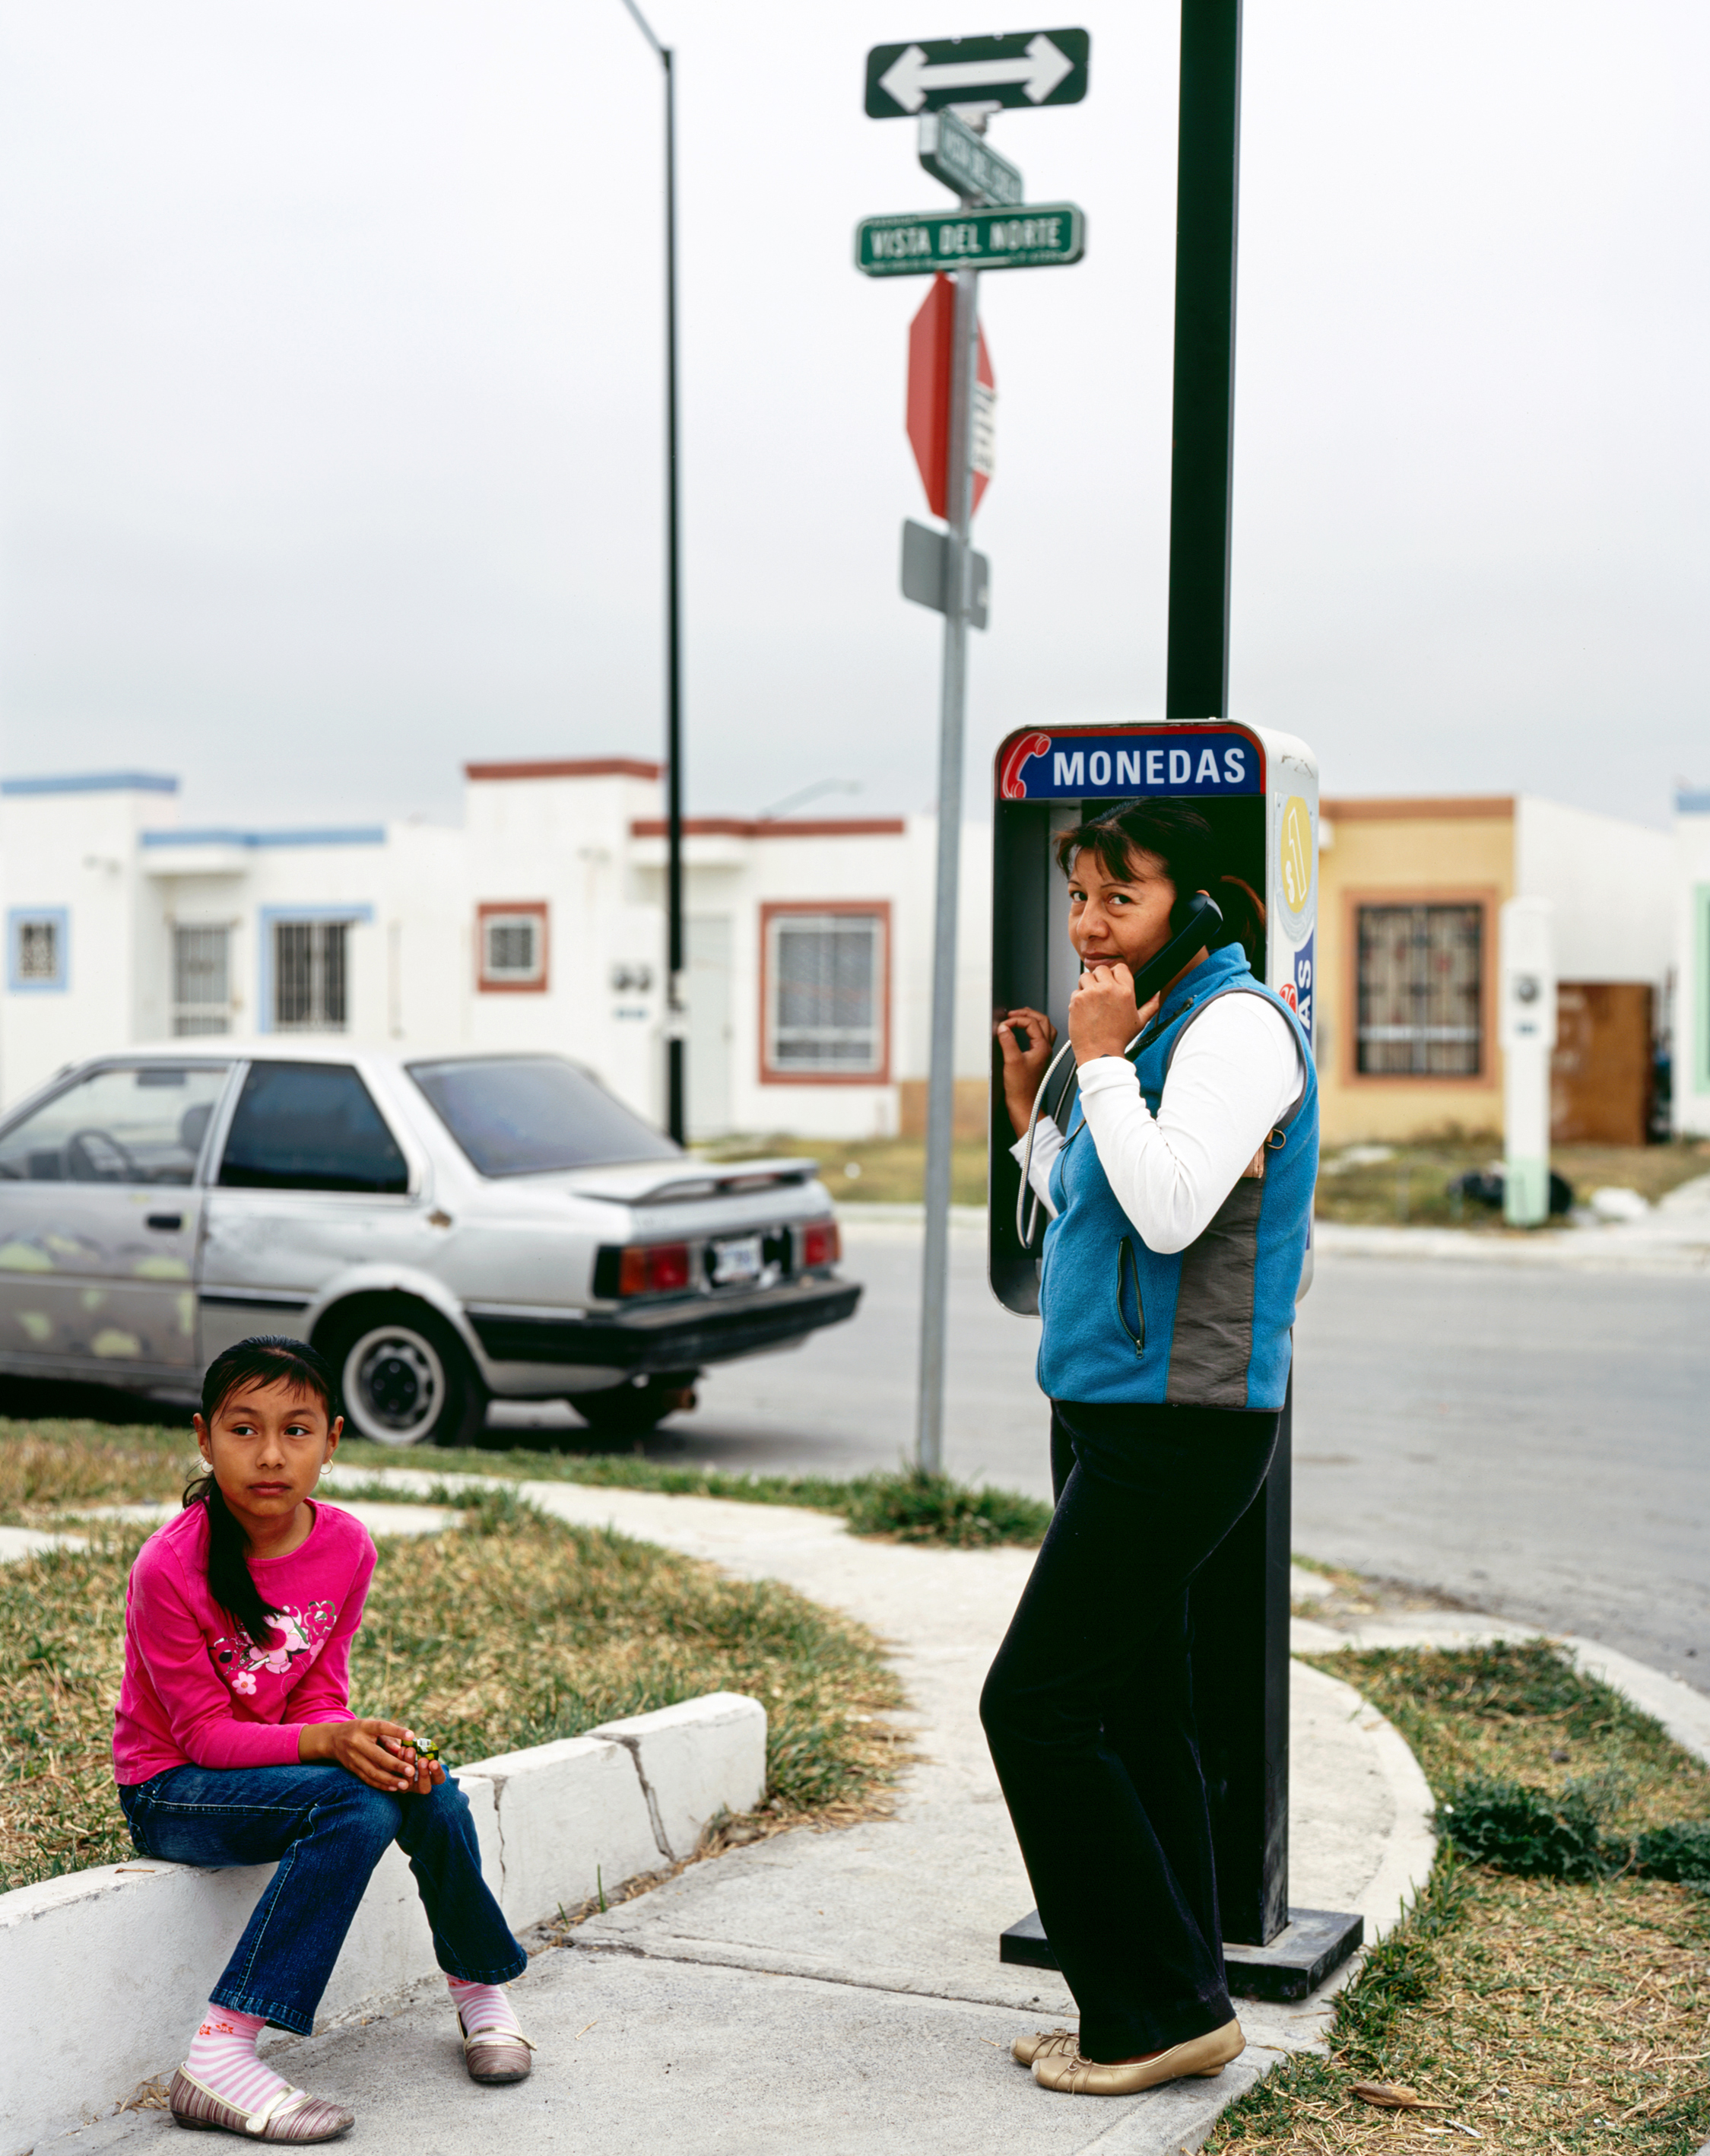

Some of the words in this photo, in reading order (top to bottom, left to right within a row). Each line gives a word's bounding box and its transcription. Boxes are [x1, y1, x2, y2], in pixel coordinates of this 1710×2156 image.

[870, 226, 932, 259] VISTA
[938, 223, 983, 255] DEL
[989, 218, 1063, 252] NORTE
[1053, 748, 1245, 786] MONEDAS
